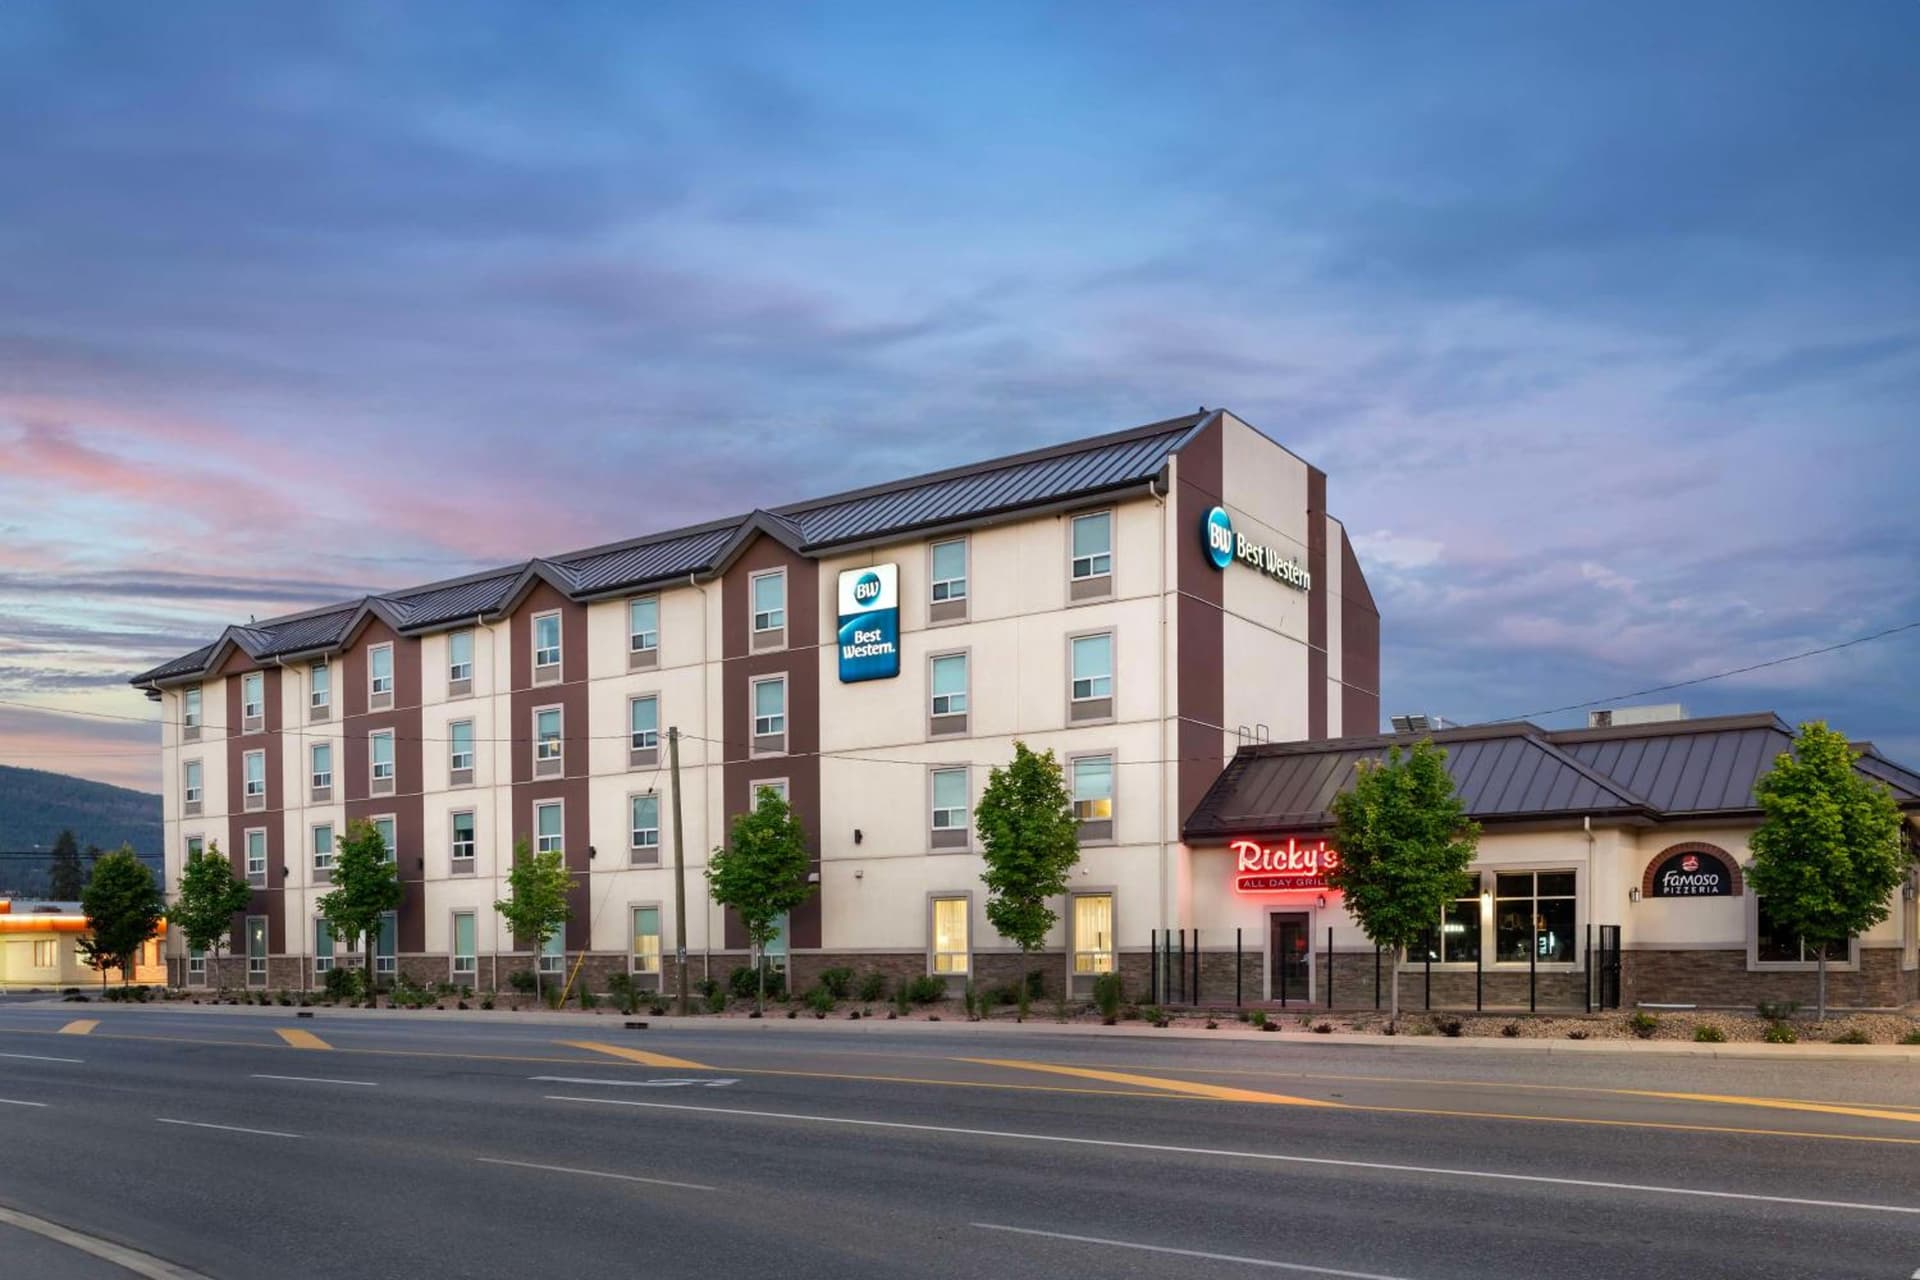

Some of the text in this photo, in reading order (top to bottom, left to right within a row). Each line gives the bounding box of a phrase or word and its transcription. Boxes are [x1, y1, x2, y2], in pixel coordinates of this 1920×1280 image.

[1210, 522, 1232, 554] BW
[1236, 532, 1311, 590] Best Western
[856, 582, 879, 599] BW
[854, 630, 881, 644] Best
[1230, 838, 1338, 876] Ricky's
[1243, 879, 1266, 888] ALL
[1269, 878, 1293, 887] DAY
[1663, 886, 1719, 894] PIZZERIA
